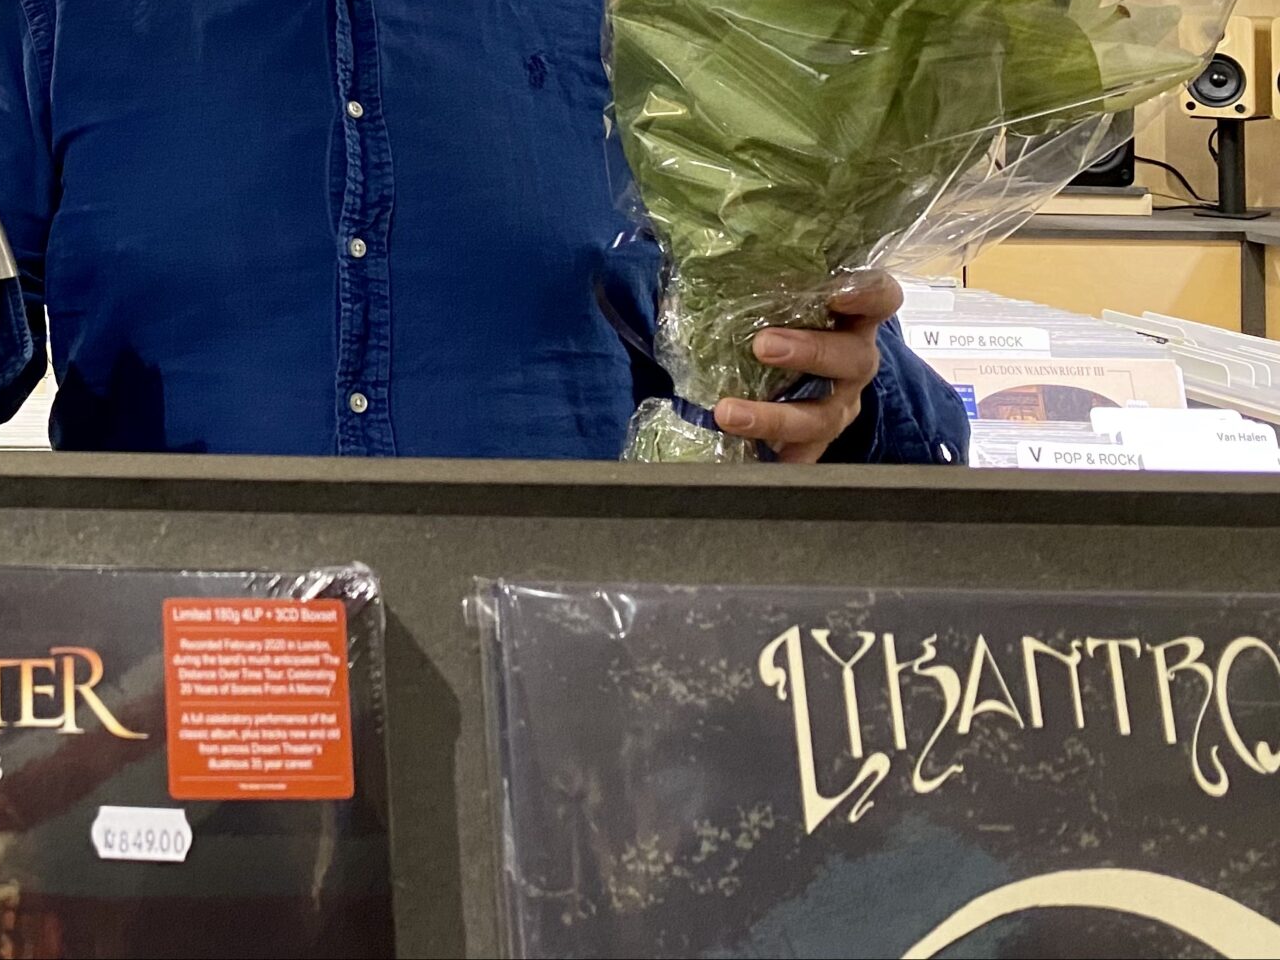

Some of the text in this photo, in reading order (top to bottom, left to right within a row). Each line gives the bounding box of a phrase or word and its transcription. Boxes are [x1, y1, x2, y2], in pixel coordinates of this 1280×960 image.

[923, 331, 1024, 348] W POP & ROCK
[979, 365, 1105, 377] LOUDON WAINWRIGHT III
[1216, 431, 1267, 442] Van Halen
[1028, 446, 1137, 466] V POP & ROCK
